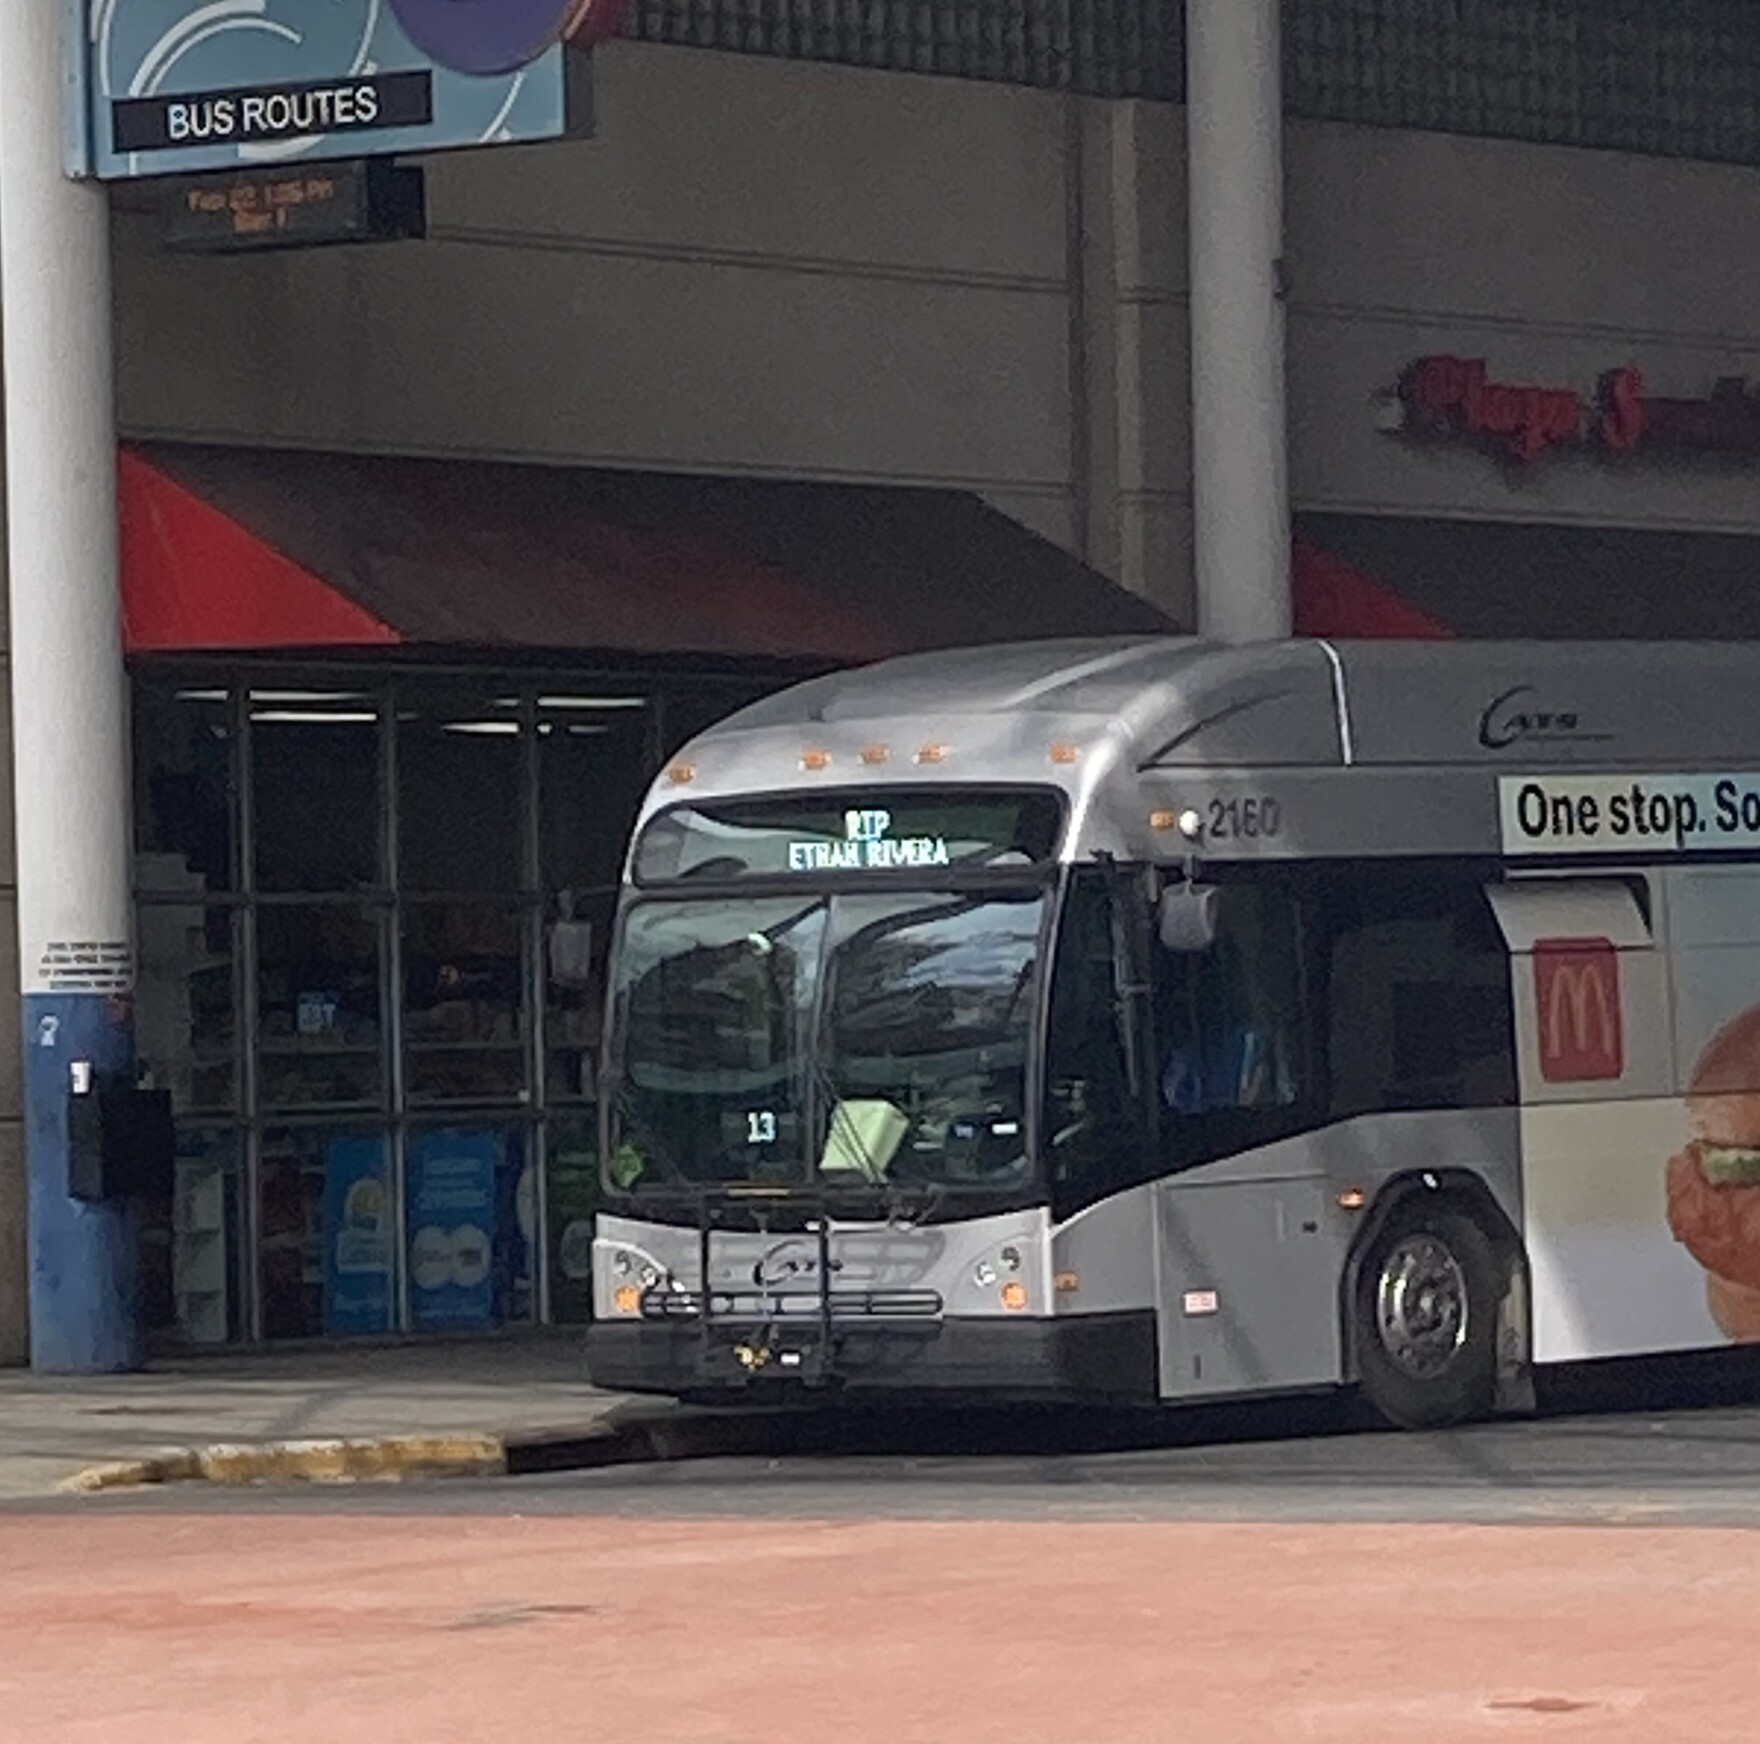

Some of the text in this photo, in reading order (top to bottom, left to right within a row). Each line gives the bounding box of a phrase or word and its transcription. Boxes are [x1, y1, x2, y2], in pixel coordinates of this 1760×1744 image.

[168, 86, 377, 139] BUS ROUTES
[845, 810, 890, 840] RIP
[1517, 784, 1599, 837] One
[1610, 784, 1706, 849] stop.
[867, 838, 949, 867] RIVERA
[748, 1111, 776, 1143] 13
